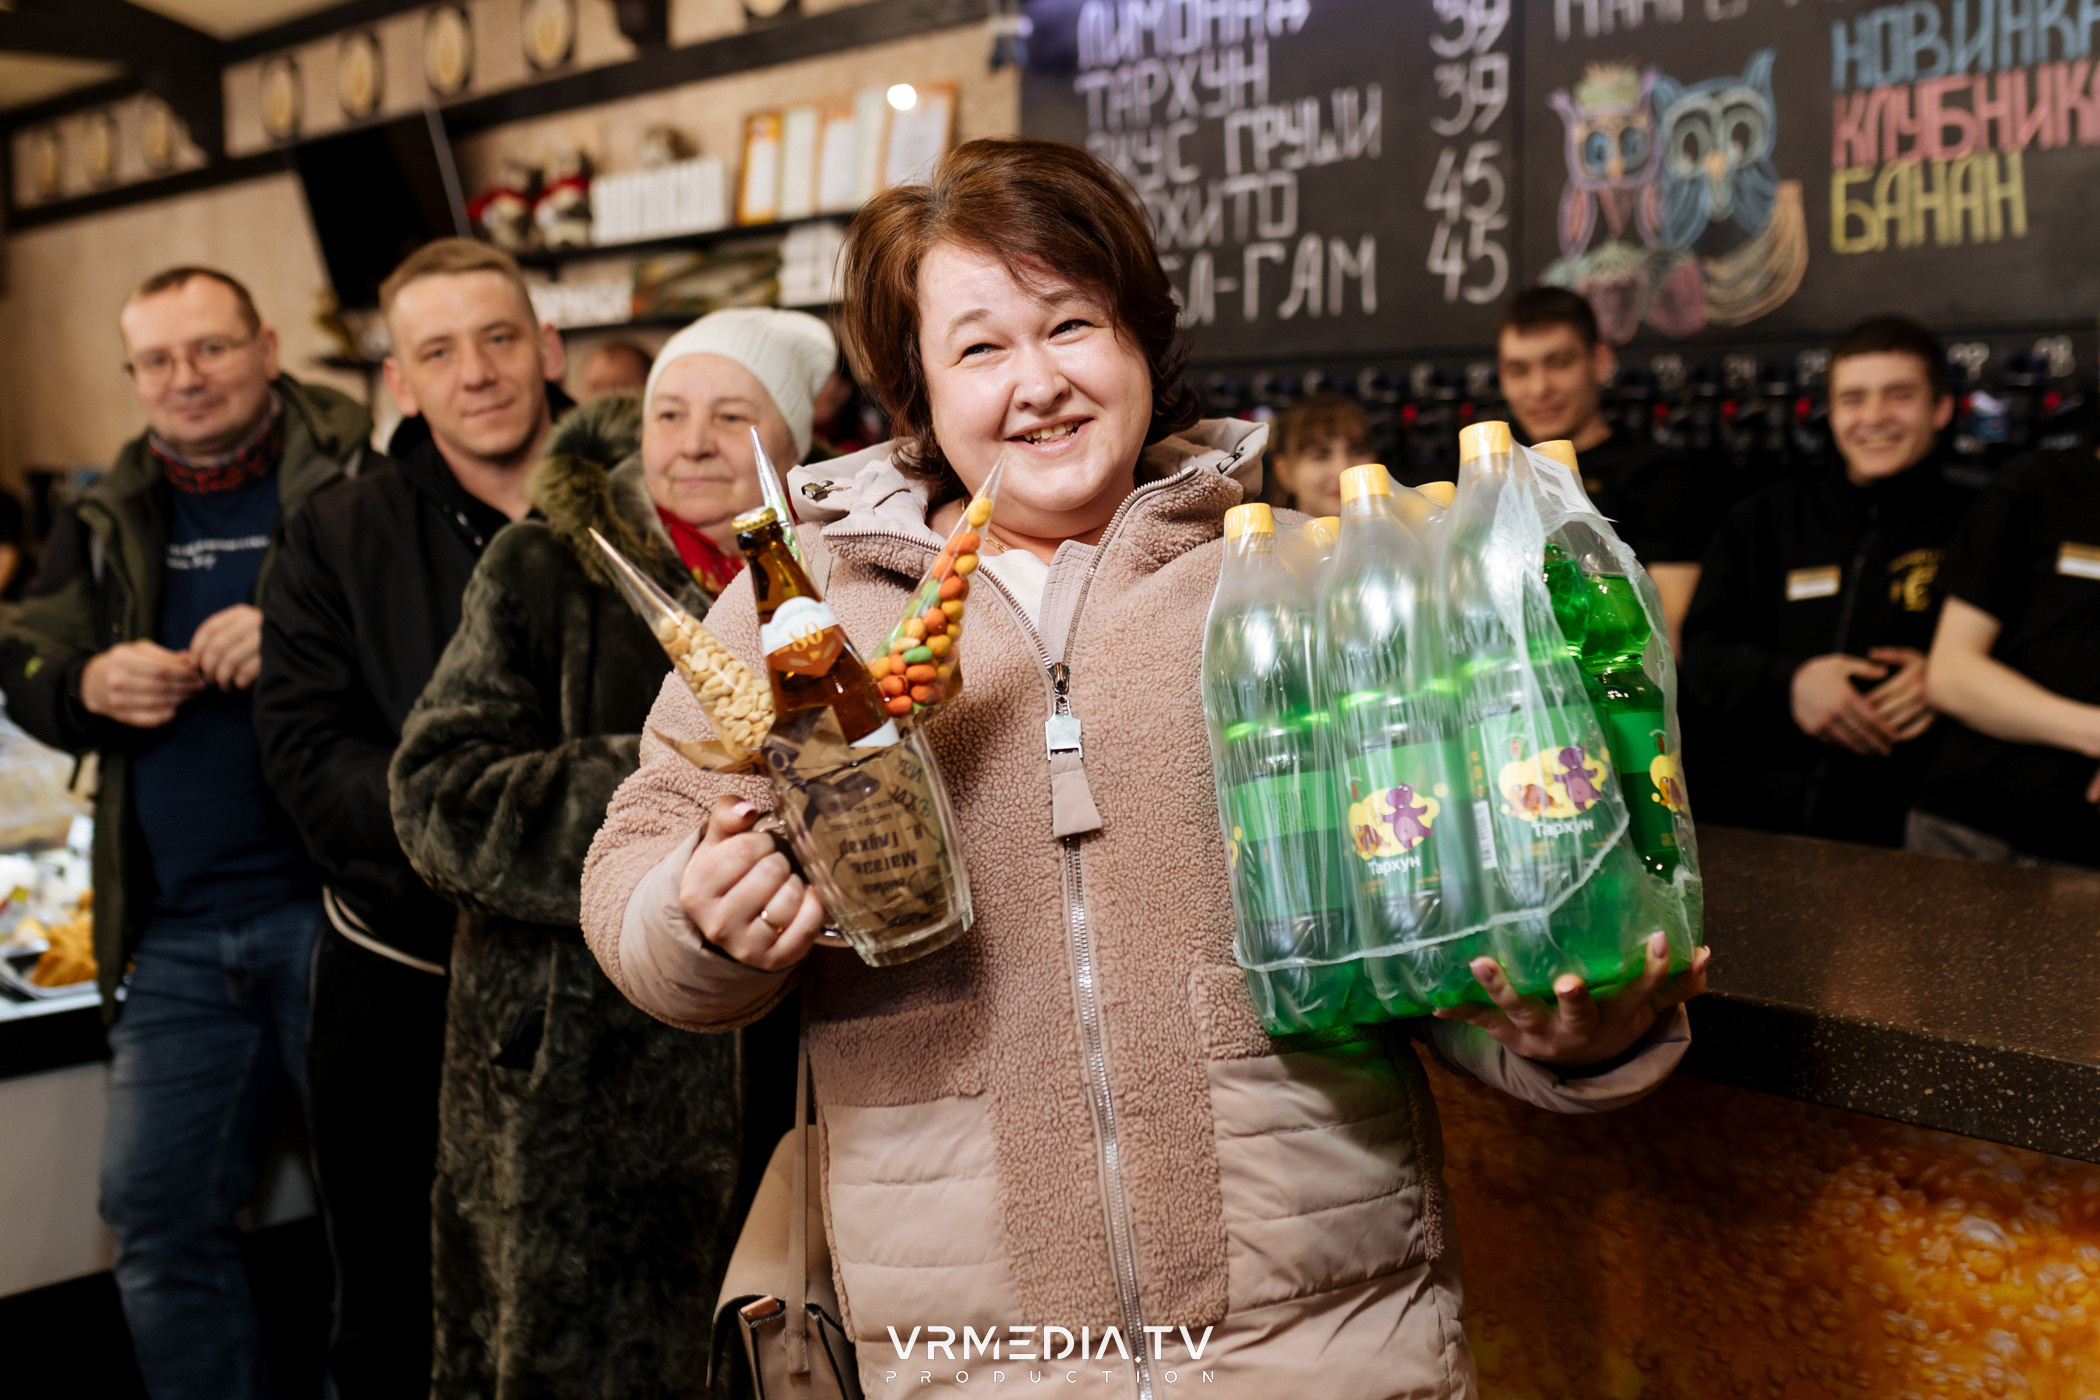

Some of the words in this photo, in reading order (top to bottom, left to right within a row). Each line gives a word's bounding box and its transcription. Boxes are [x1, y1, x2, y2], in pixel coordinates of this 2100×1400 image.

[1073, 39, 1269, 134] ТАРХУН
[1430, 51, 1509, 137] 39
[1832, 57, 2100, 171] КЛУБНИК
[1224, 81, 1383, 176] ГРУШИ
[1424, 140, 1506, 224] 45
[1831, 146, 2027, 255] БАНАН
[1427, 213, 1510, 305] 45
[1368, 856, 1421, 876] Тархун
[1530, 818, 1594, 839] Тархун
